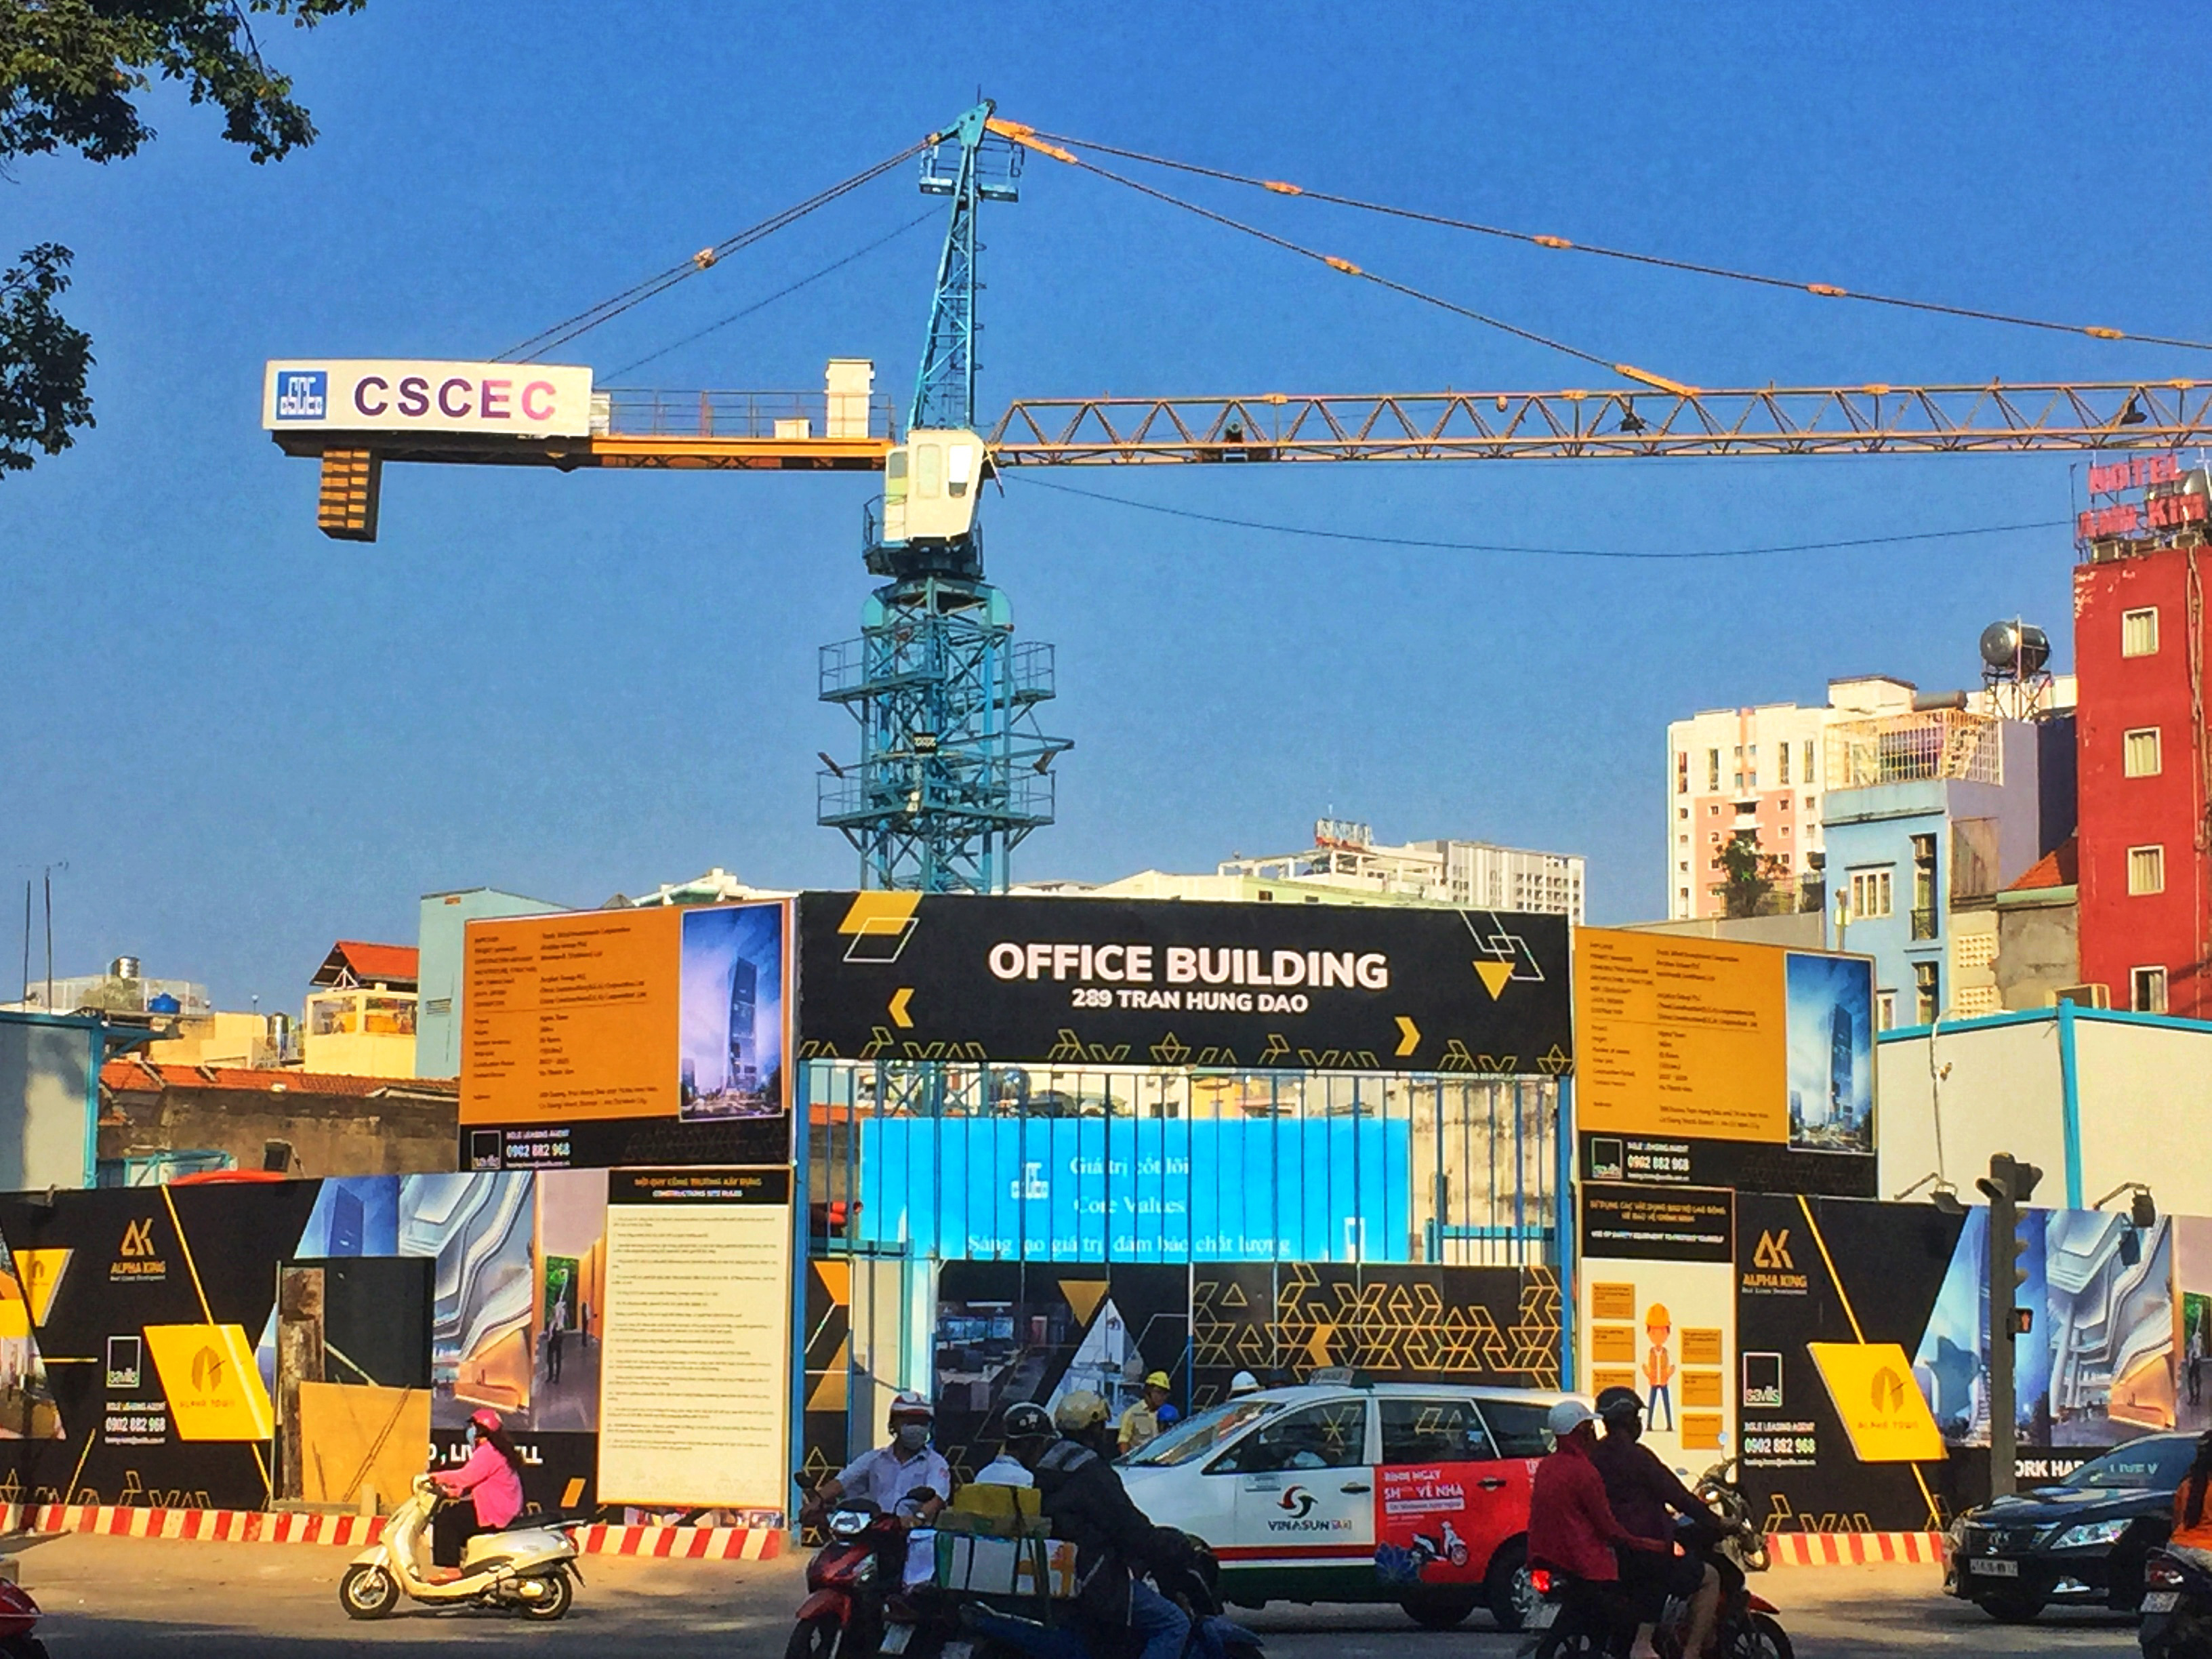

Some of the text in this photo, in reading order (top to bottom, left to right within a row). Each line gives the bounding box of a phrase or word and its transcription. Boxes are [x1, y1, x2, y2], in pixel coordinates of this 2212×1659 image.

[354, 377, 556, 421] CSCEC
[989, 942, 1388, 989] OFFICE BUILDING
[1072, 988, 1308, 1013] 289 TRAN HUNG DAO
[1073, 1196, 1186, 1214] Core Values
[1743, 1273, 1778, 1286] ALPHA
[1745, 1437, 1816, 1454] 0902 882 968
[2014, 1460, 2049, 1477] ORK
[1268, 1520, 1330, 1531] VINASUN
